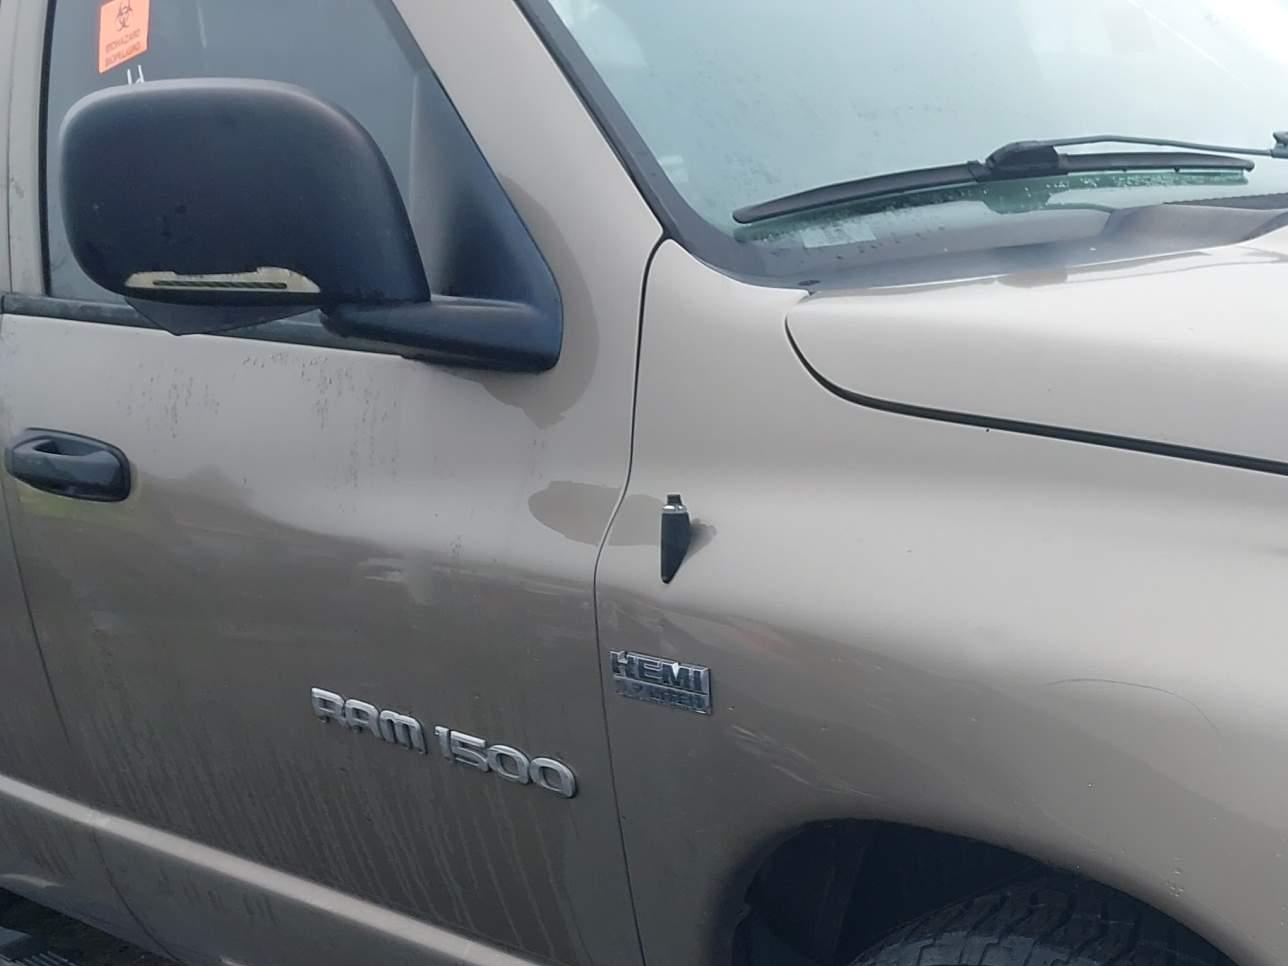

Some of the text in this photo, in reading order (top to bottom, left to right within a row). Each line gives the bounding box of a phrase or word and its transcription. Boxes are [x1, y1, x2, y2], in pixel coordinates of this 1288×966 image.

[609, 650, 711, 695] HEMI
[311, 687, 579, 799] RAM 1500
